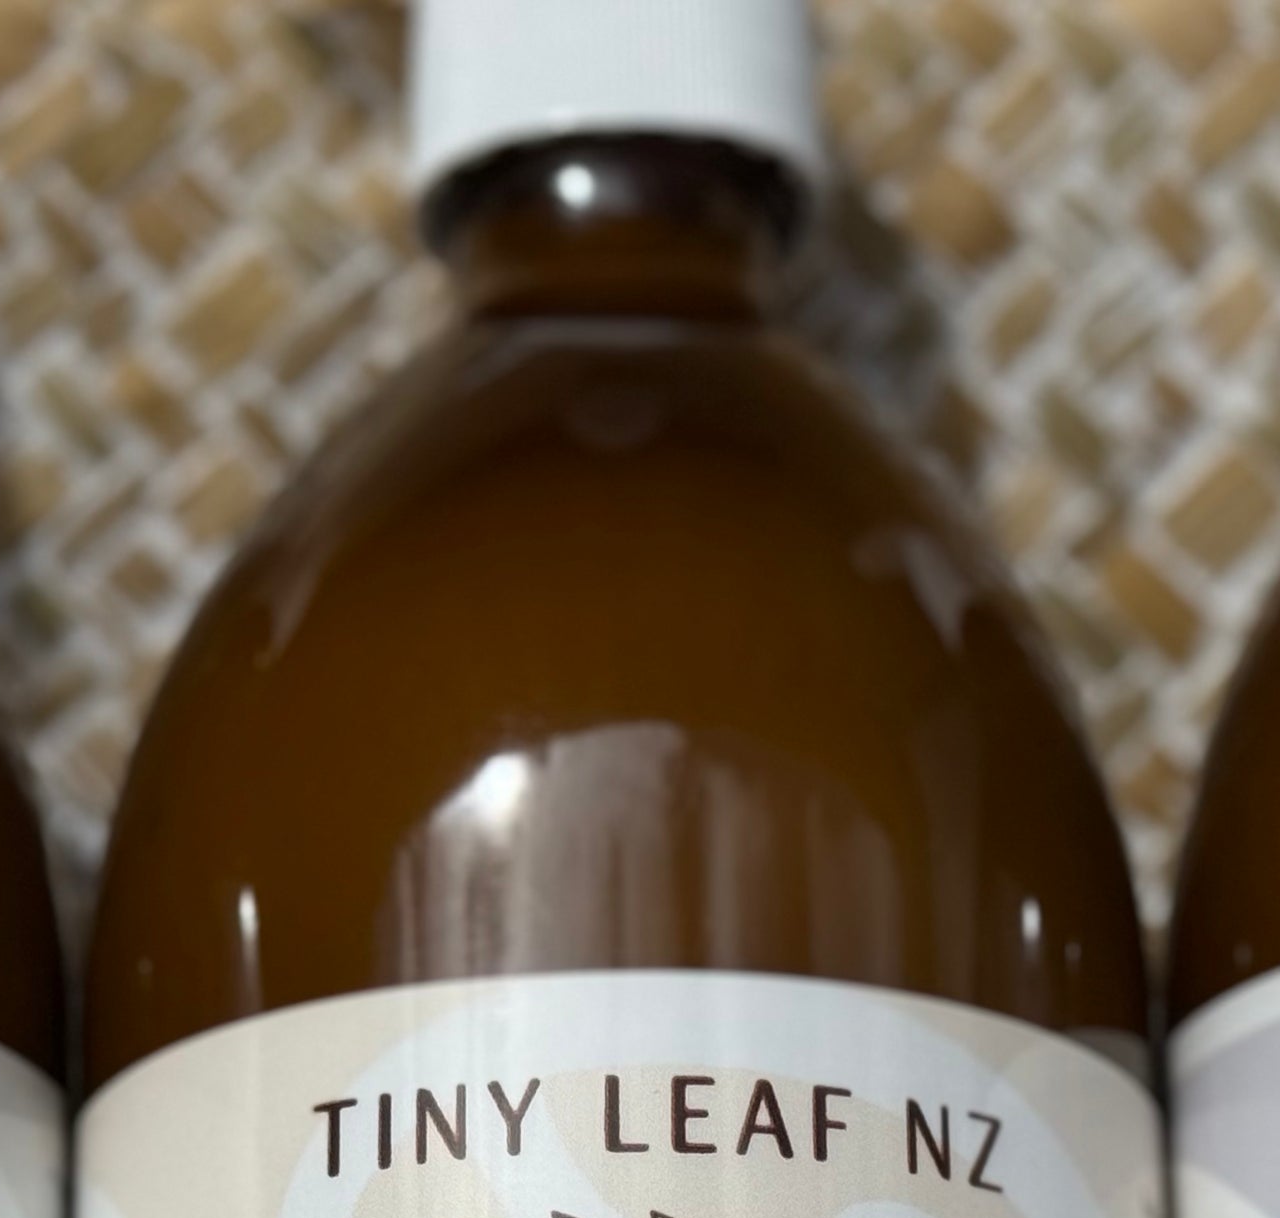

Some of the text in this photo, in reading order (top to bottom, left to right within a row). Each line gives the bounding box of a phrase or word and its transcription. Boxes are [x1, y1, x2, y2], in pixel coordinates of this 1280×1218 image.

[312, 1074, 1003, 1194] TINY LEAF NZ
